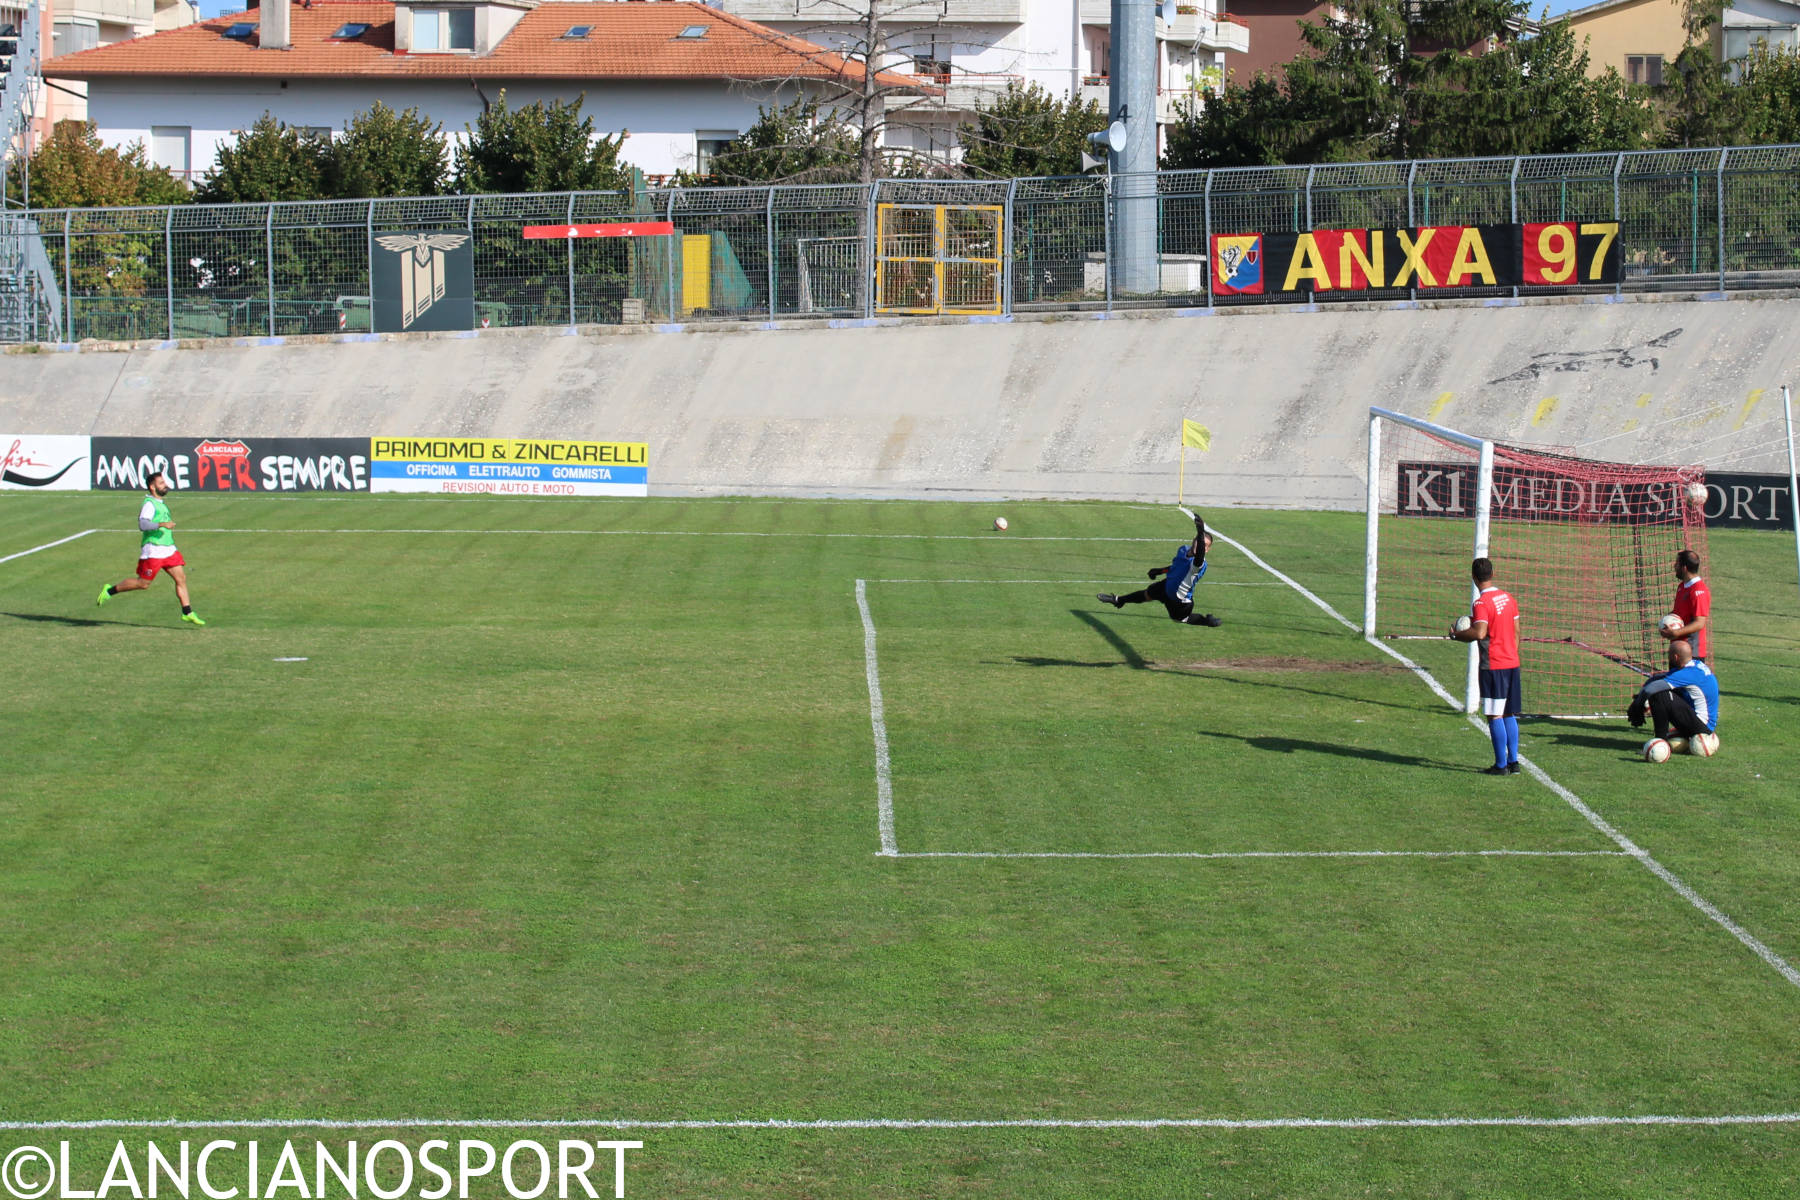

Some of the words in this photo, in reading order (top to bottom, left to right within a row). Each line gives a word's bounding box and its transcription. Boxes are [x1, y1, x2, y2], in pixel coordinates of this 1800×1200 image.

[1117, 103, 1132, 124] 4
[1282, 227, 1497, 291] ANXA
[1537, 222, 1619, 283] 97
[203, 445, 244, 454] LANCIANO
[375, 440, 485, 459] PRIMOMO
[492, 445, 506, 459] &
[514, 443, 645, 463] ZINCARELLI
[97, 454, 190, 490] AMORE
[197, 455, 257, 491] PER
[260, 454, 367, 491] SEMPRE
[406, 463, 457, 477] OFFICINA
[468, 465, 541, 478] ELETTRAUTO
[552, 468, 612, 480] GOMMISTA
[442, 481, 497, 493] REVISIONI
[500, 483, 529, 493] AUTO
[532, 484, 539, 493] E
[542, 484, 575, 495] MOTO
[1490, 477, 1631, 516] MEDIA
